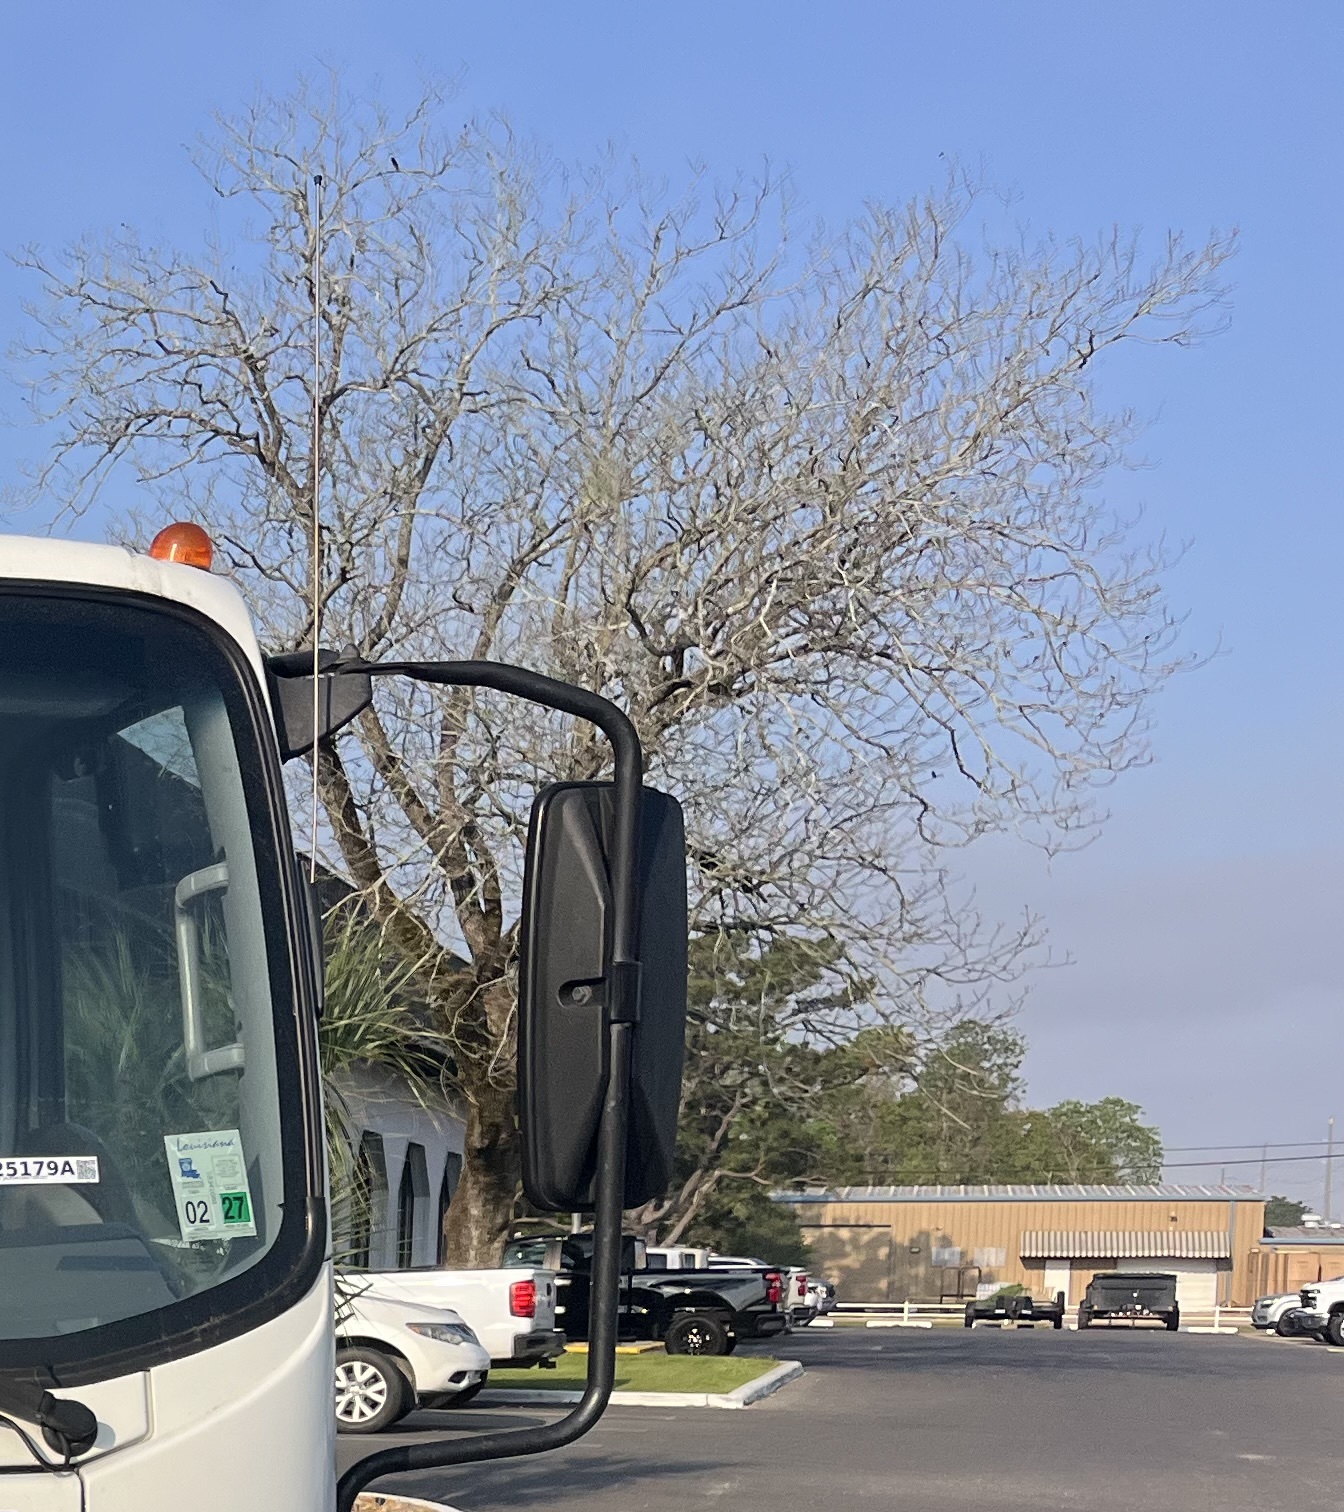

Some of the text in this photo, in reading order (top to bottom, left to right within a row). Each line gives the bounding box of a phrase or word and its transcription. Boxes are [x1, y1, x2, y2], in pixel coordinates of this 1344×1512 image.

[176, 1138, 235, 1152] Louisiana
[184, 1196, 244, 1224] 02 27
